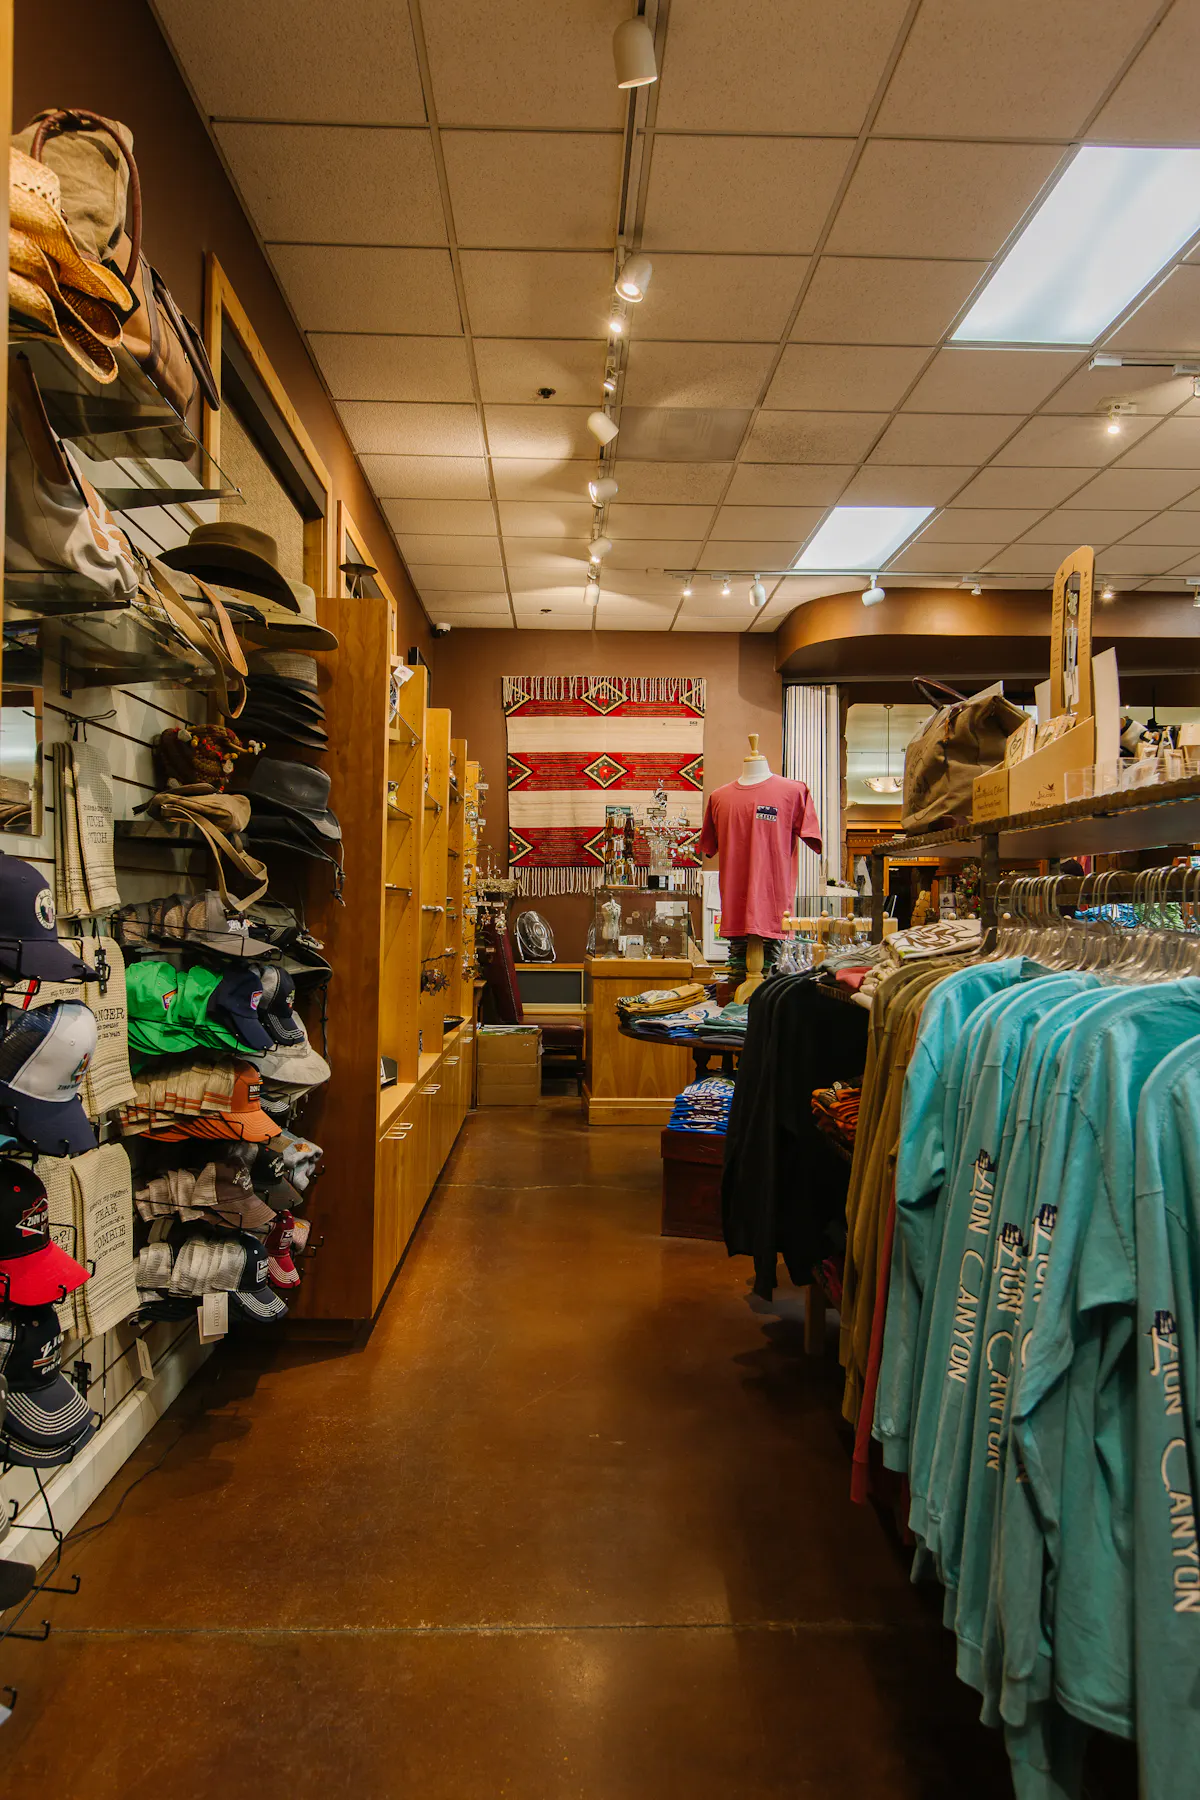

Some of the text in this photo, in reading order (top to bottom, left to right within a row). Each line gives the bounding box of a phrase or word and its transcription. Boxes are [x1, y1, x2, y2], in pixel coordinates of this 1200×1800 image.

[93, 1223, 126, 1254] ZOMBIE
[94, 1202, 118, 1224] FEAR
[946, 1159, 995, 1385] ZION CANYON
[1160, 1438, 1200, 1613] CANYON
